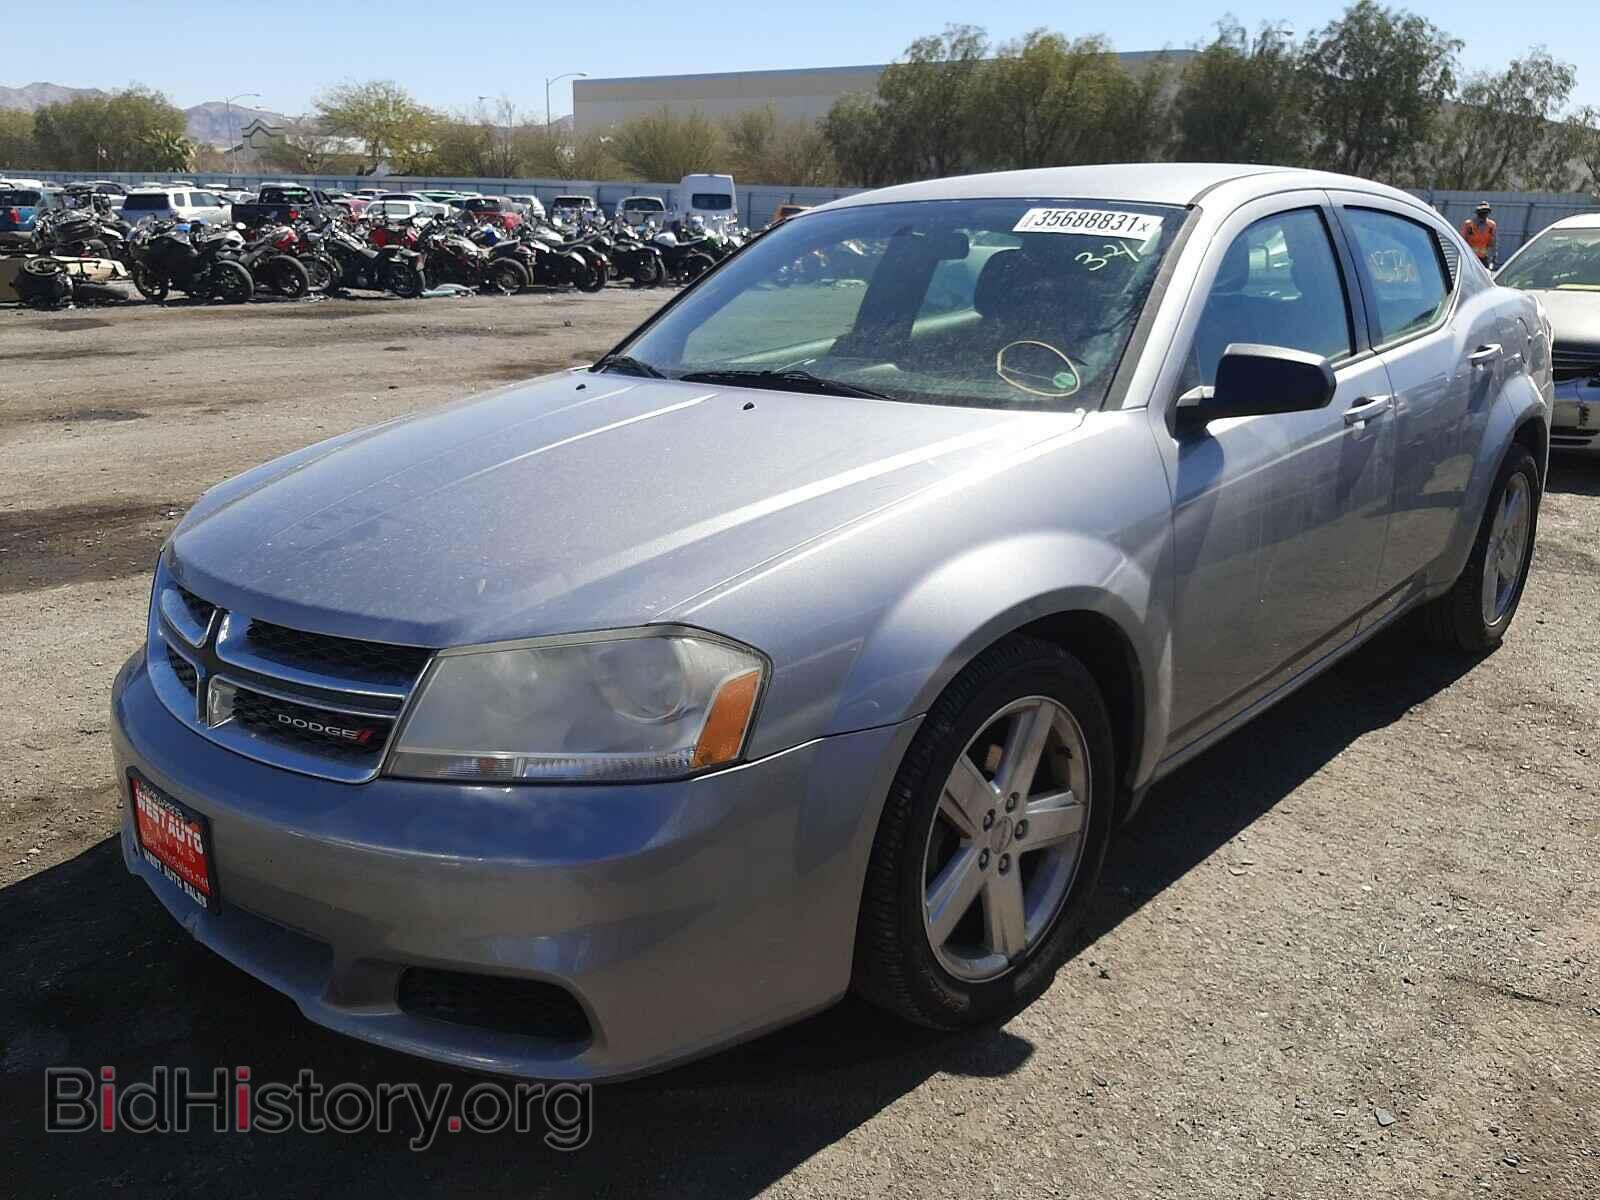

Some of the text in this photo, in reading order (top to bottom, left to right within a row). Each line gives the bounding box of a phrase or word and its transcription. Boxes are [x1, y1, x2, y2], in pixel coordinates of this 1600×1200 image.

[278, 713, 360, 741] DODGE
[136, 788, 166, 829] WEST
[168, 814, 204, 855] AUTO
